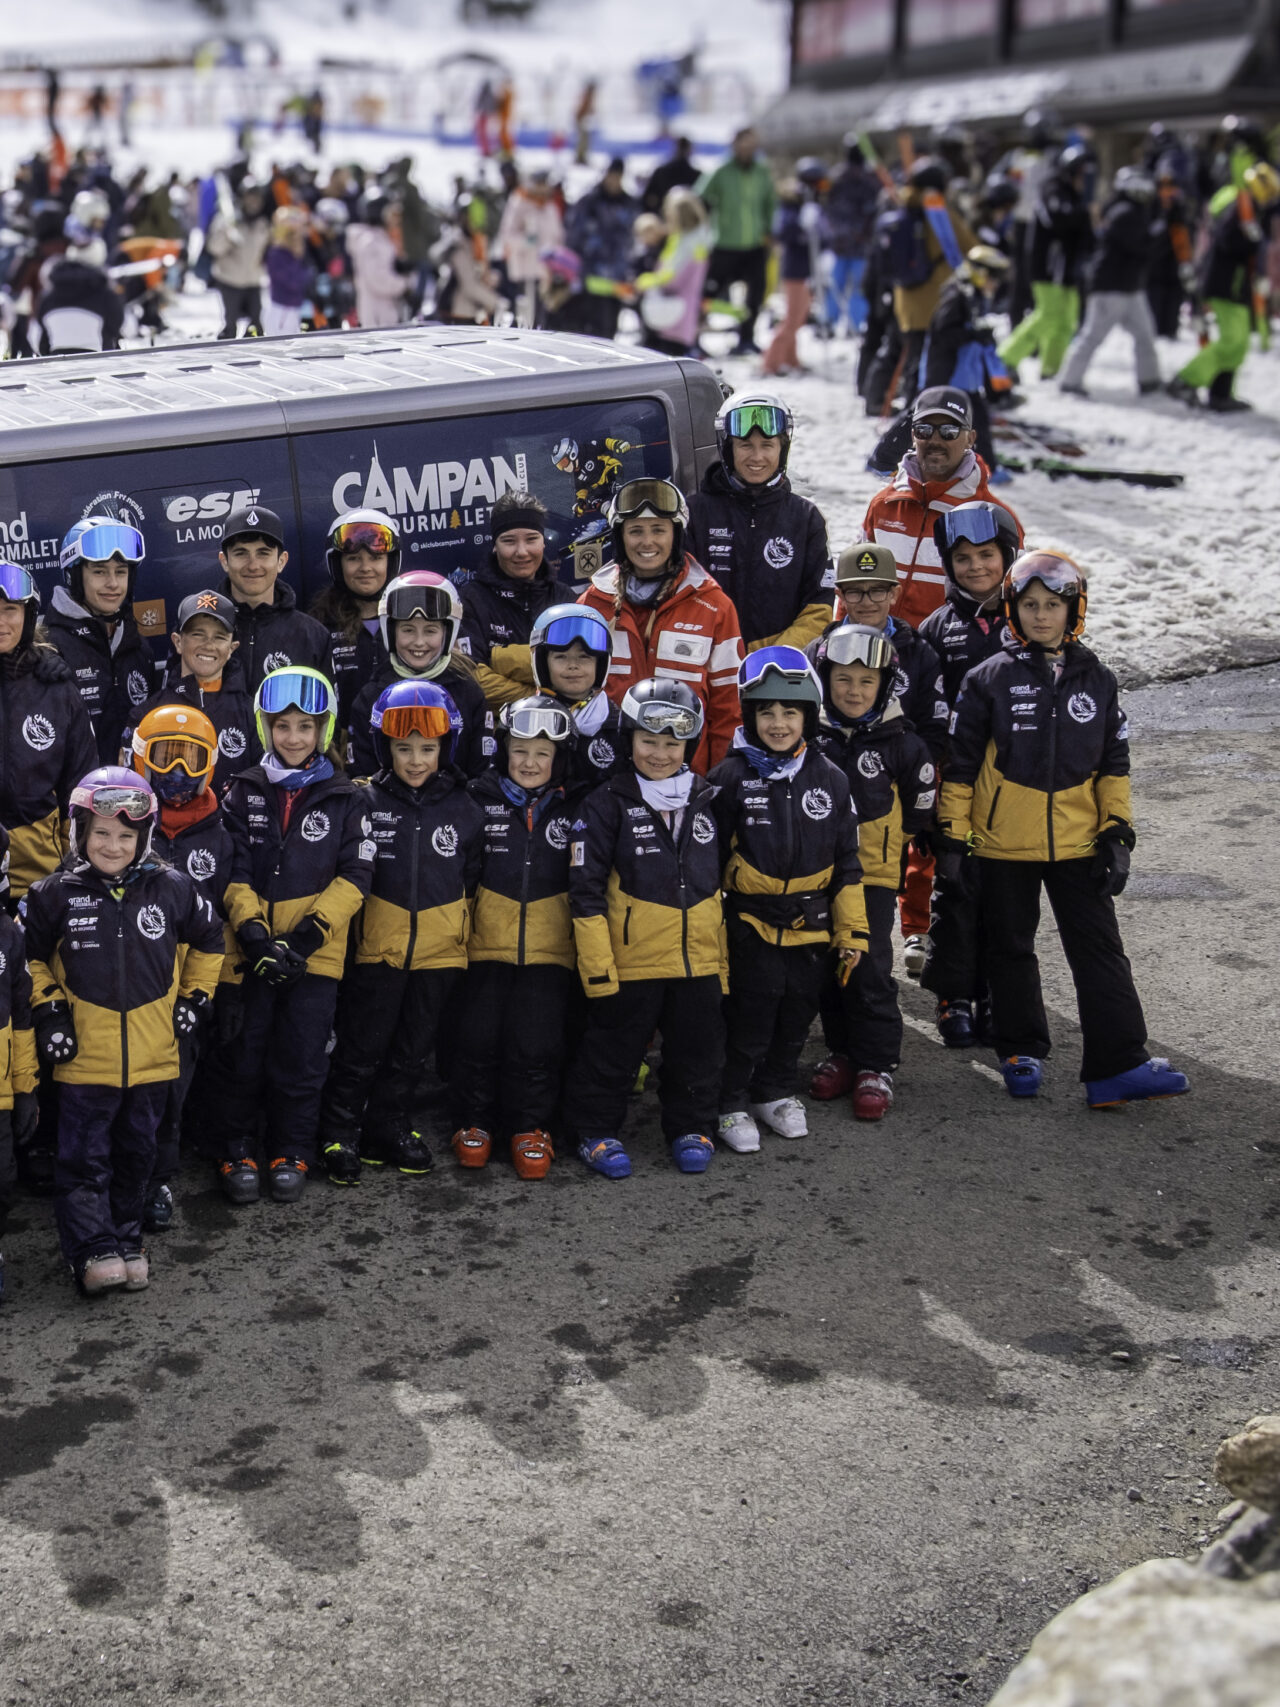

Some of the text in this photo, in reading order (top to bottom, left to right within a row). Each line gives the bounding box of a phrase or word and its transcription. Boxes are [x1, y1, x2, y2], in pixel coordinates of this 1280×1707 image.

[332, 440, 527, 515] CAMPAN
[176, 529, 194, 543] LA
[35, 562, 43, 570] DU
[45, 560, 60, 569] MIDI
[248, 795, 265, 803] gran
